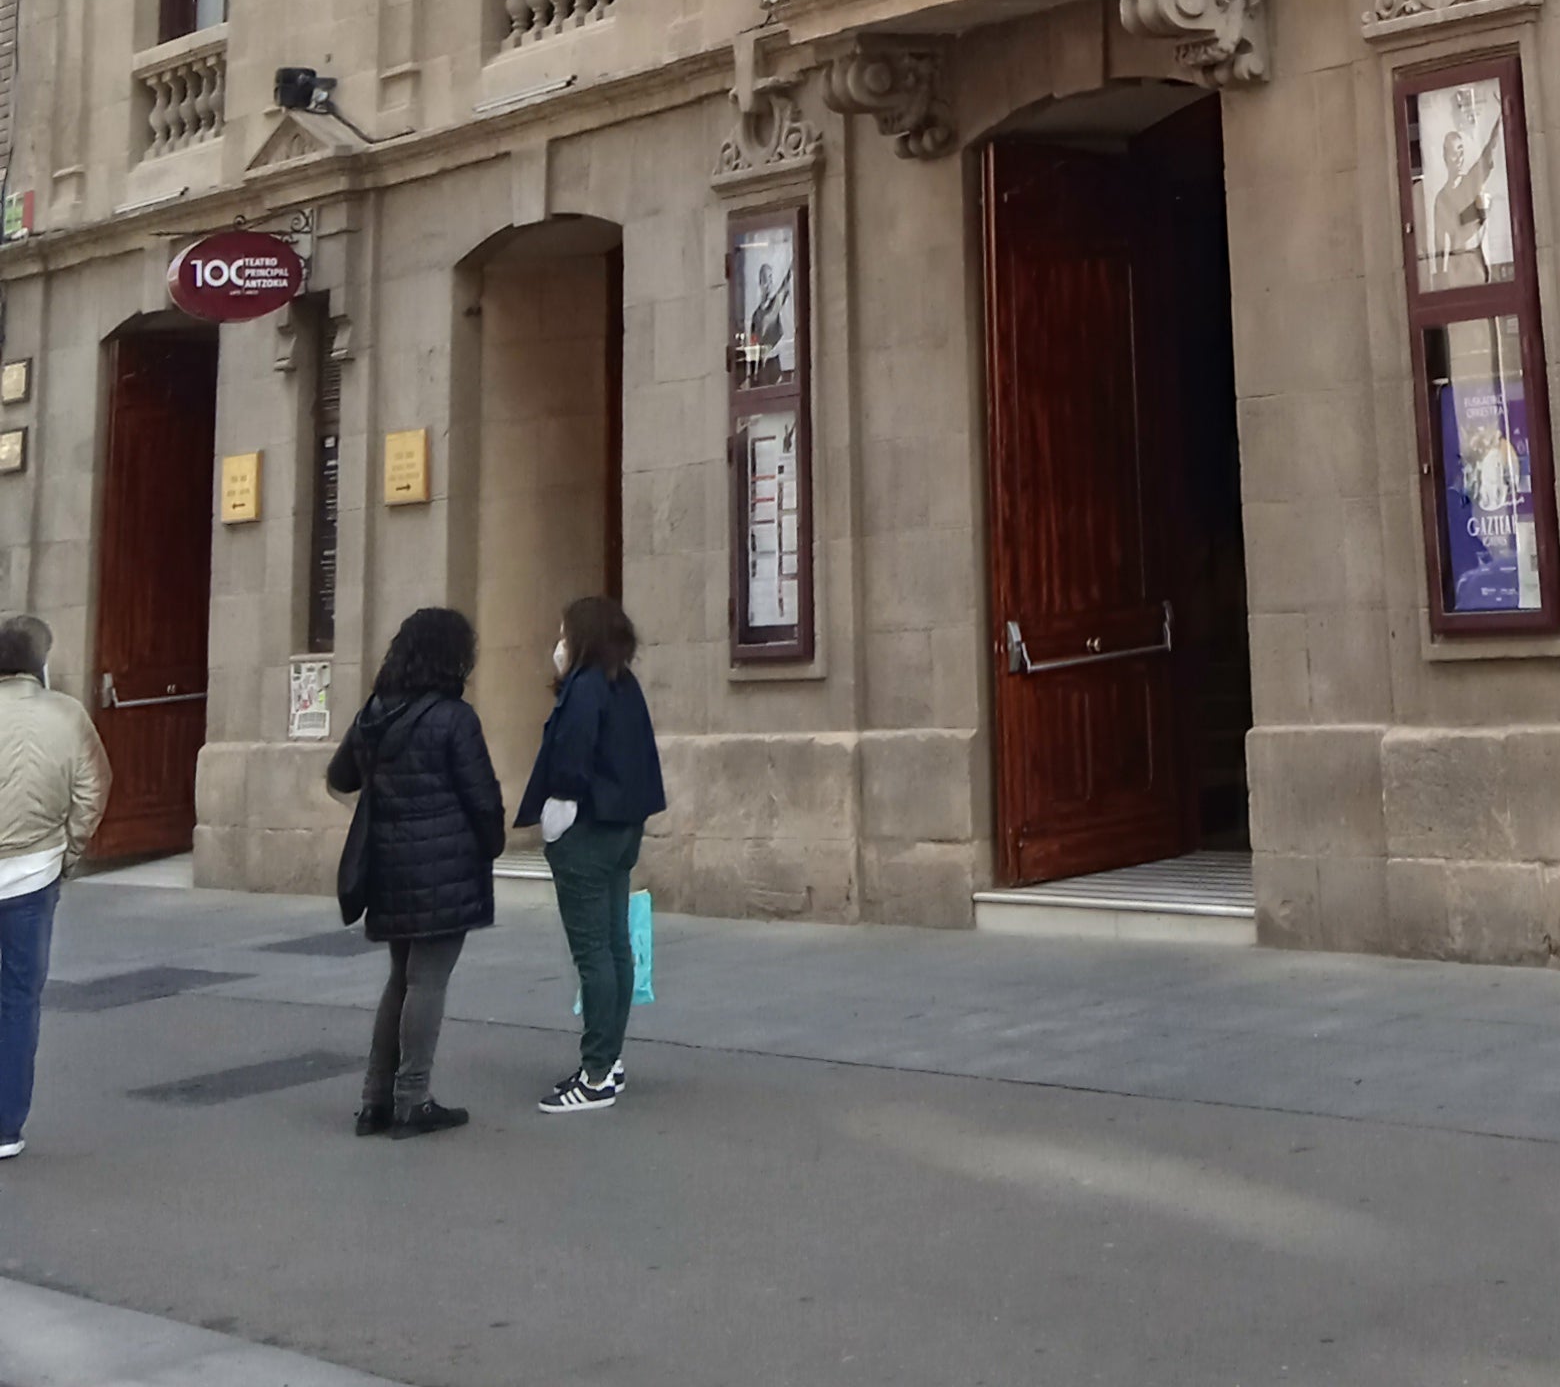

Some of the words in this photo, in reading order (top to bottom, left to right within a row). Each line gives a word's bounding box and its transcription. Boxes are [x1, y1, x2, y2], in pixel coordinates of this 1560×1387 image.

[244, 257, 278, 267] TEATRO
[244, 267, 289, 278] PRINCIPAL
[244, 278, 288, 289] ANTZOKIA
